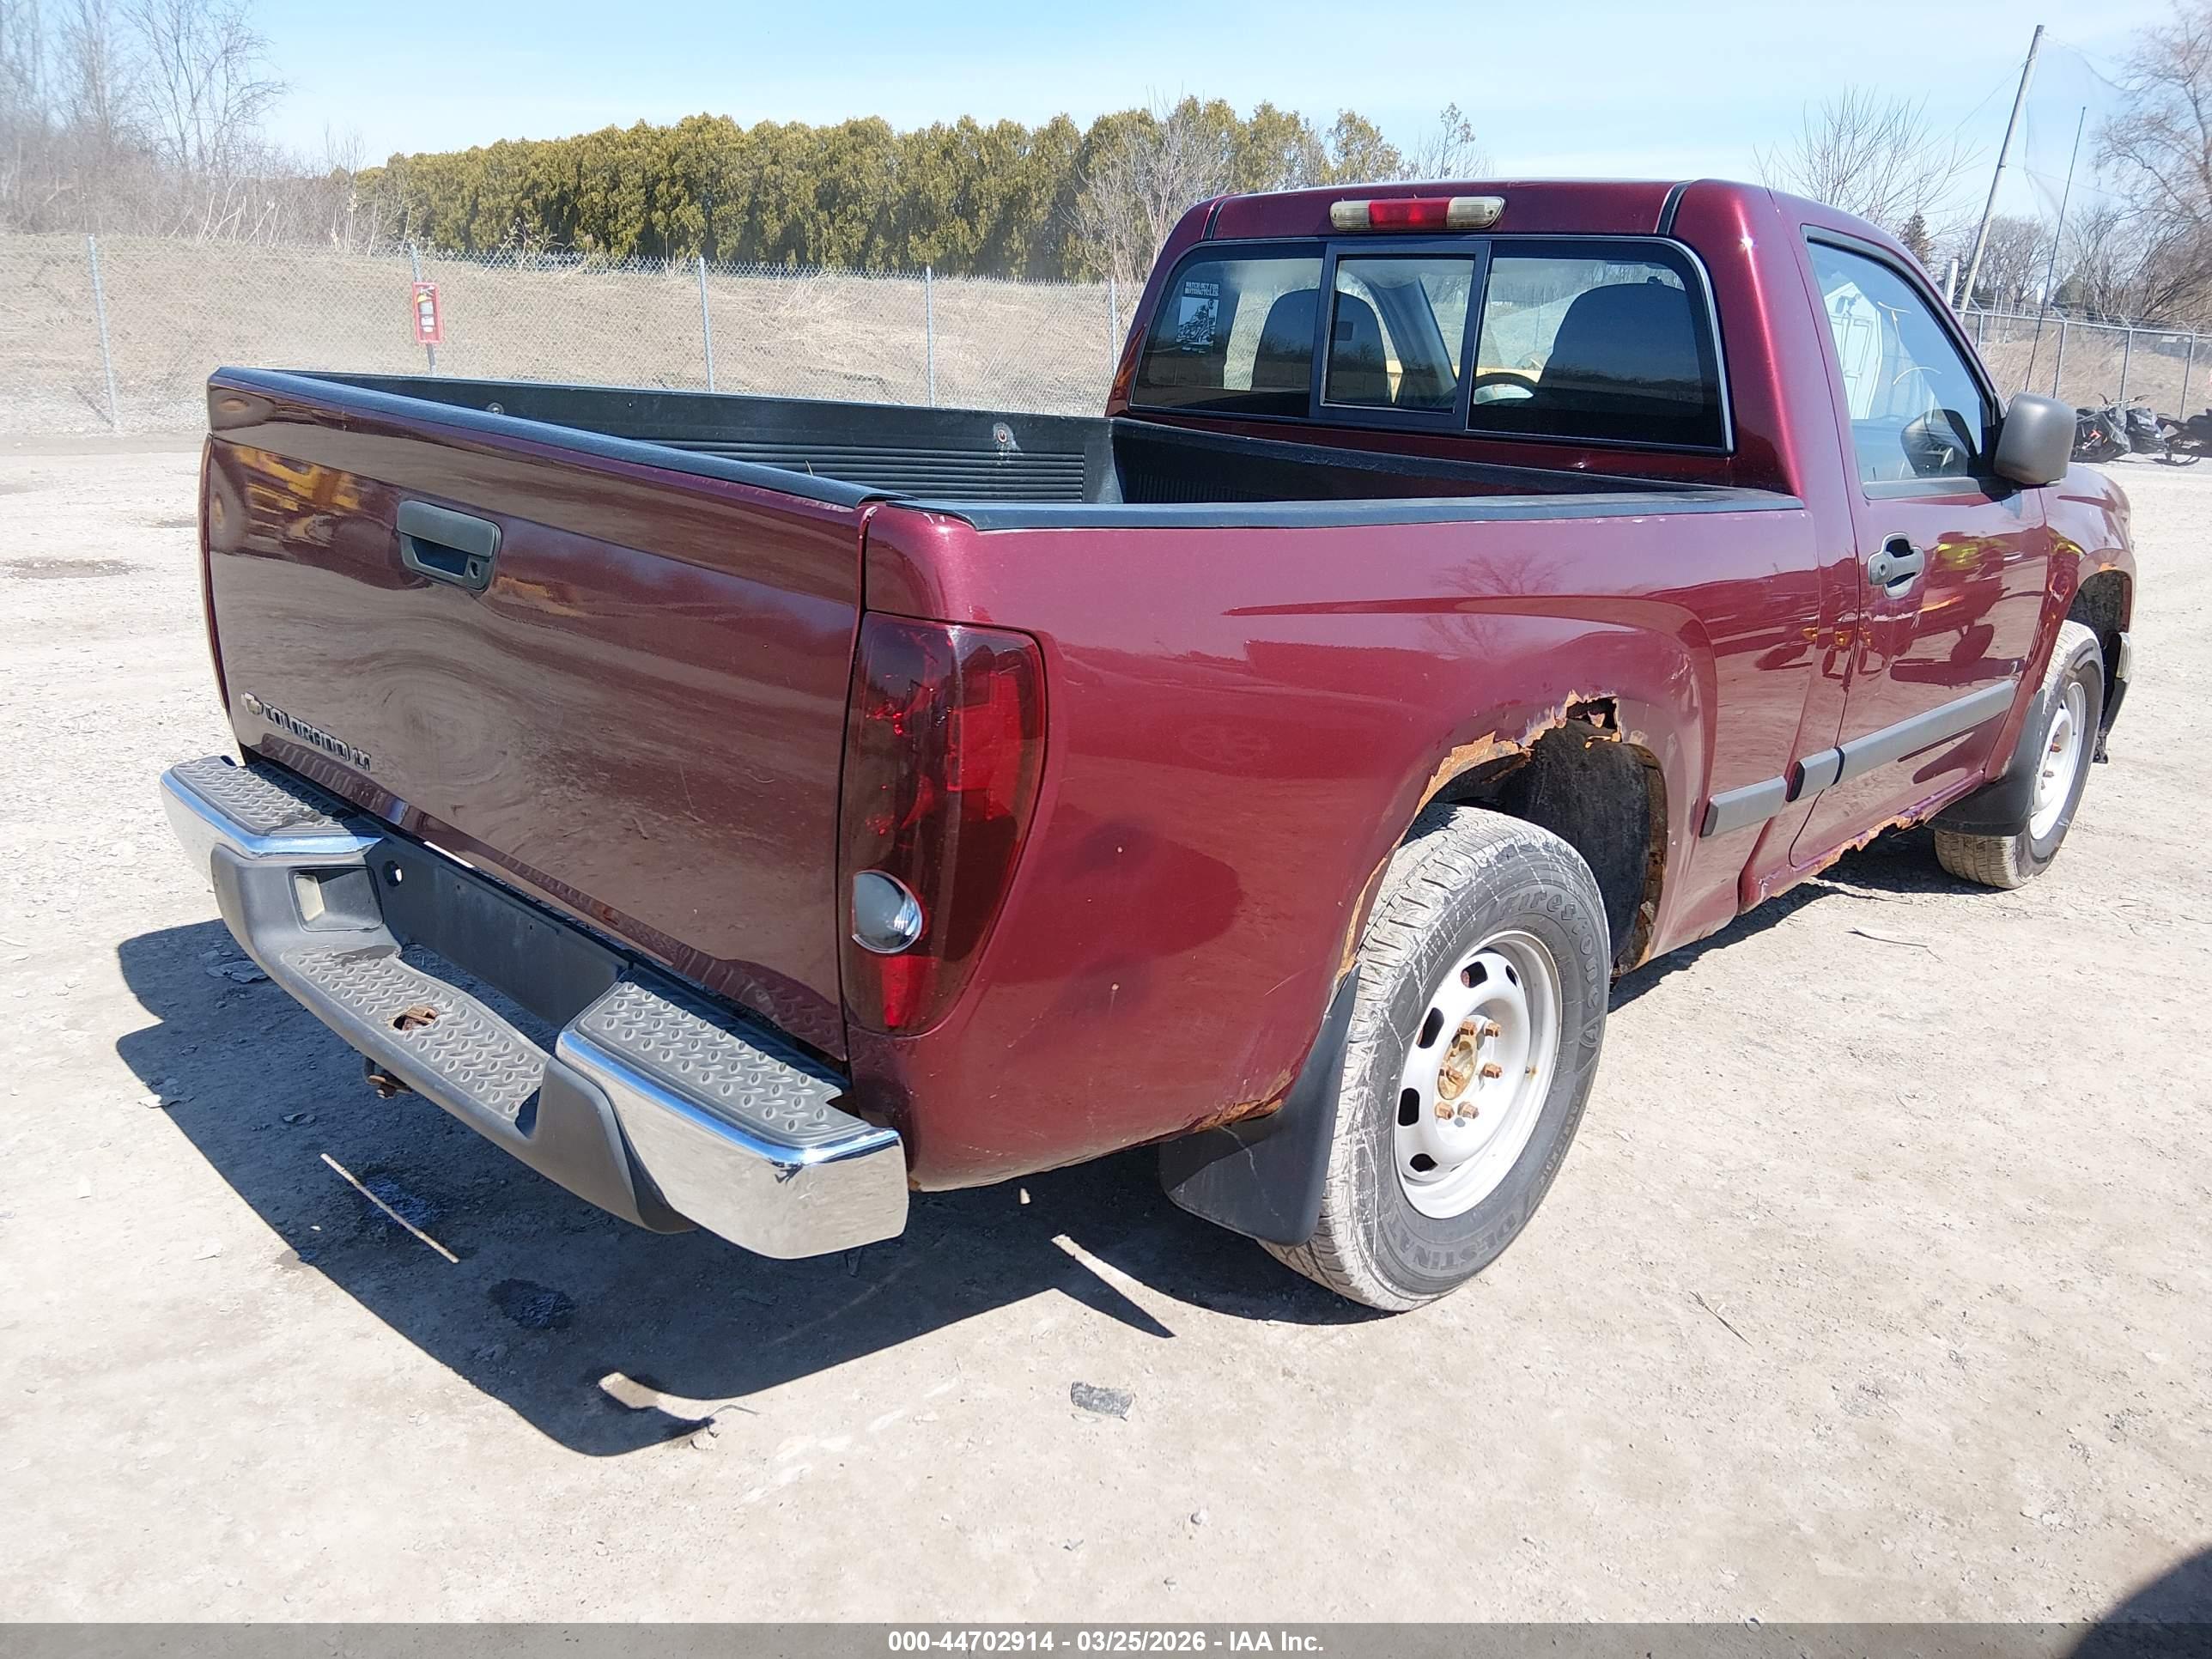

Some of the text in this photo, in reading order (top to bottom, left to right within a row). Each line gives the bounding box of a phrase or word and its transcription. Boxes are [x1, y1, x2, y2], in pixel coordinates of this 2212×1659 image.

[1185, 288, 1218, 296] MOTORCYCLES
[262, 702, 349, 761] COLORADO
[1501, 890, 1599, 1009] Firestone
